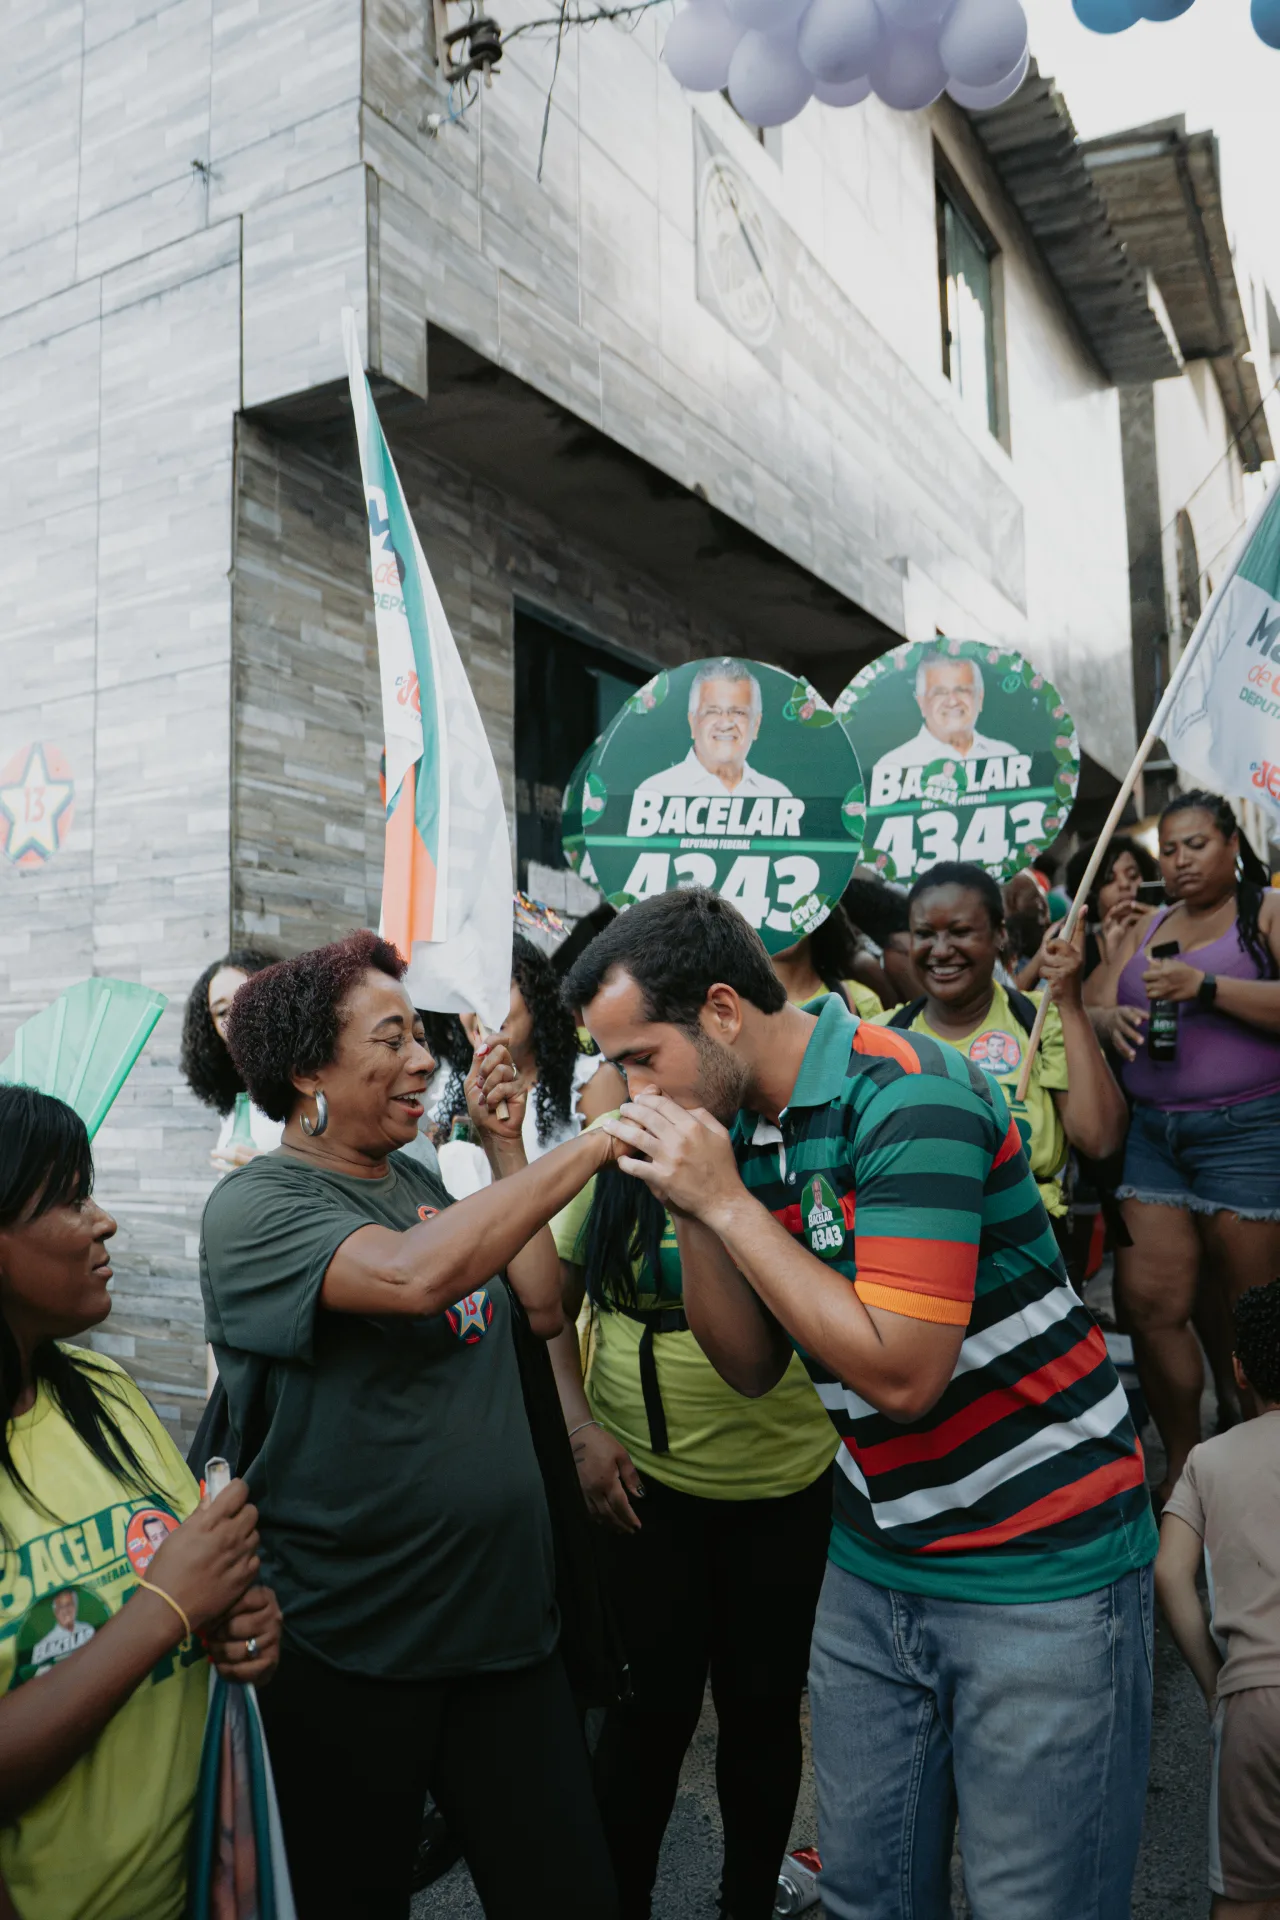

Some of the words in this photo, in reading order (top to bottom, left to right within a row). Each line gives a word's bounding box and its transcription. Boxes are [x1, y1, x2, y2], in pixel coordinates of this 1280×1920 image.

[1248, 663, 1272, 688] de
[870, 754, 1032, 807] BALAR
[24, 786, 46, 823] 13
[627, 789, 805, 837] BACELAR
[808, 1210, 833, 1228] BACELAR
[812, 1225, 843, 1251] 4343
[0, 1500, 158, 1624] BACELA
